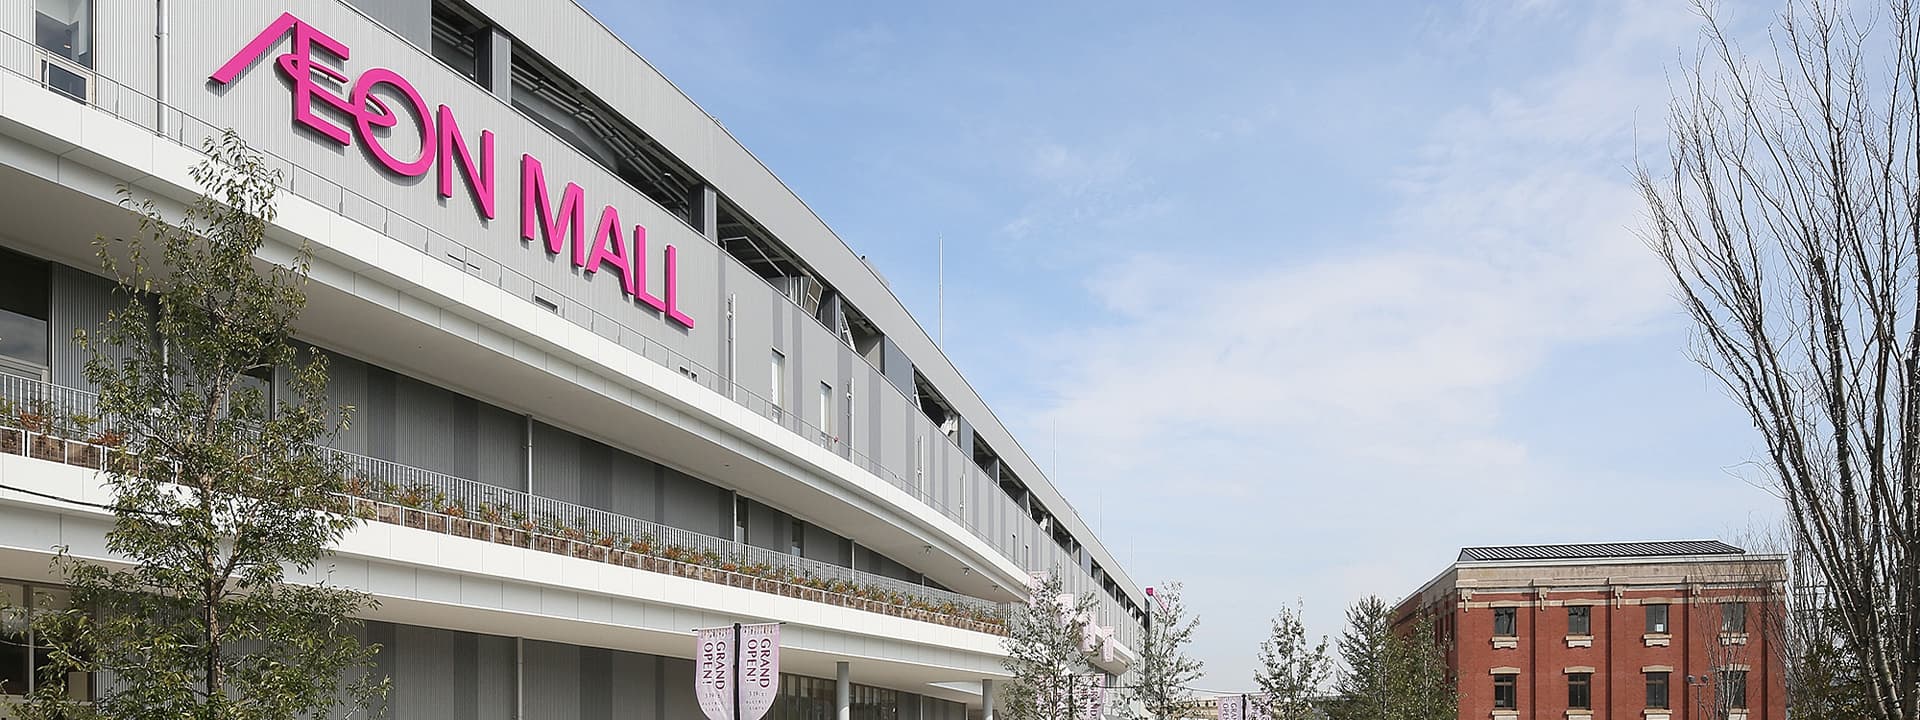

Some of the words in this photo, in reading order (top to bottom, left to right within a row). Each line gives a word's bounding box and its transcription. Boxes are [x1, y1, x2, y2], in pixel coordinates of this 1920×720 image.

[521, 153, 695, 329] MALL
[702, 642, 714, 686] OPEN!
[715, 641, 727, 690] GRAND
[746, 639, 758, 682] OPEN!
[759, 638, 772, 688] GRAND
